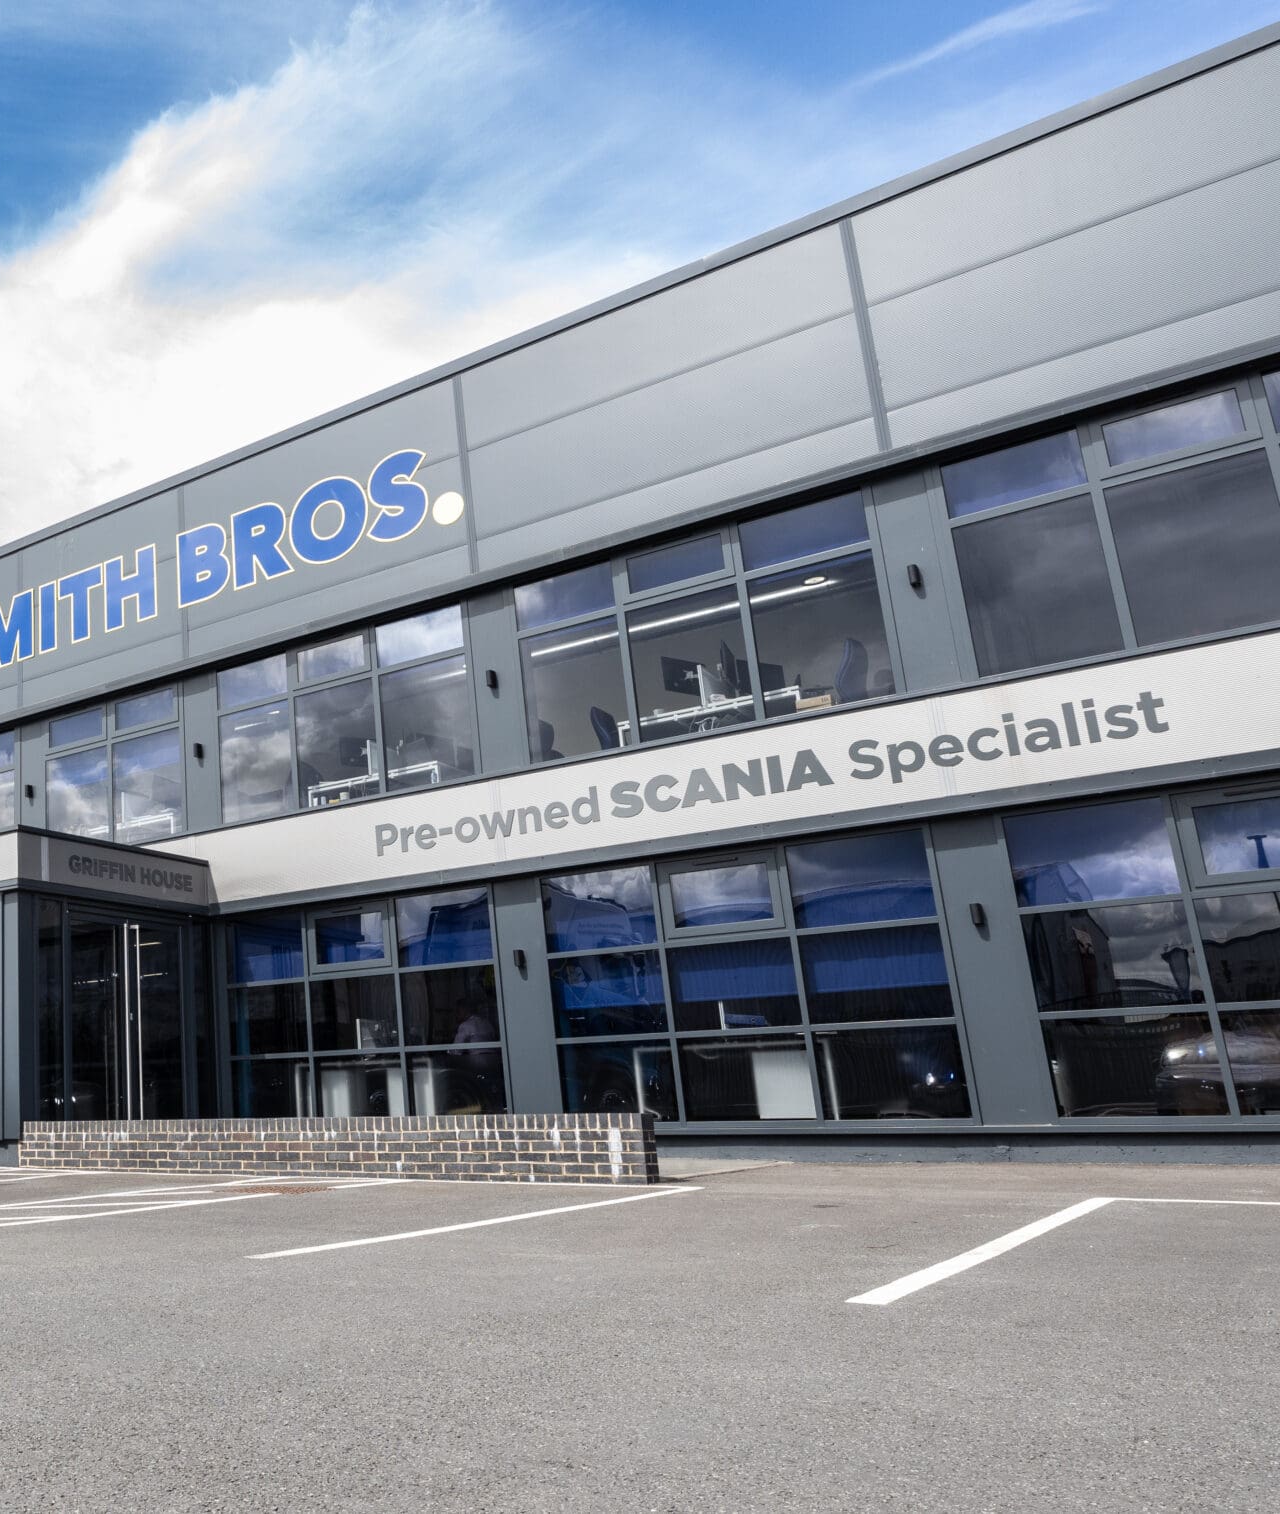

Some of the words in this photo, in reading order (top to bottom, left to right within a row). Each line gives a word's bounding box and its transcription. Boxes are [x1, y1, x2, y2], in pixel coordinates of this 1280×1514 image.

[176, 449, 465, 608] BROS.
[374, 786, 601, 857] Pre-owned
[609, 749, 834, 818] SCANIA
[849, 691, 1170, 784] Specialist
[68, 854, 137, 882] GRIFFIN
[140, 866, 194, 893] HOUSE
